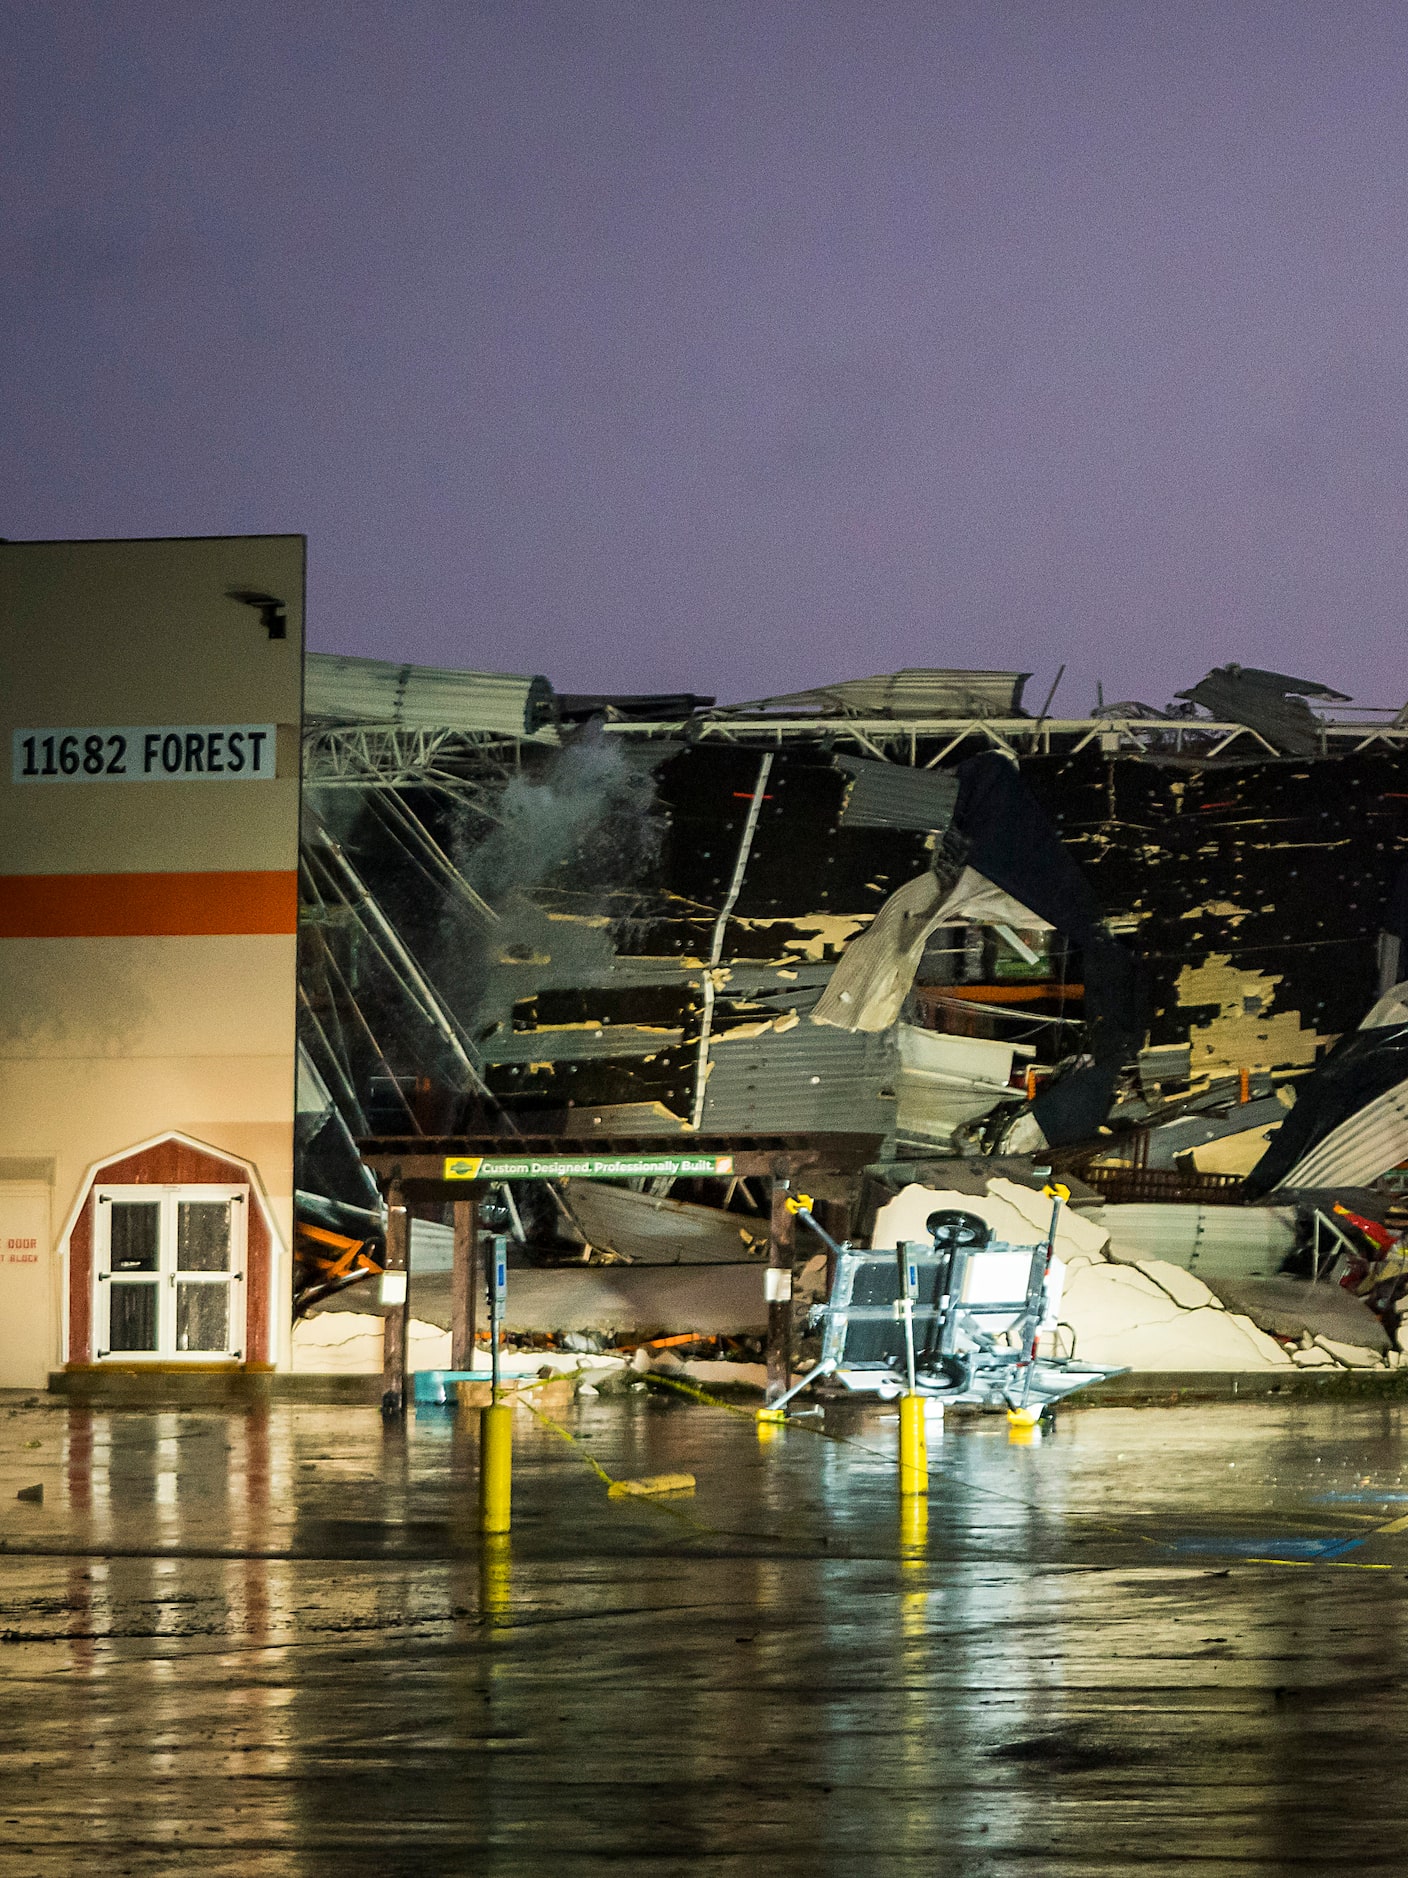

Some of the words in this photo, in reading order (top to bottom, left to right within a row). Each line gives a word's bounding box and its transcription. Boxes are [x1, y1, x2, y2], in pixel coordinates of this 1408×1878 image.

[22, 735, 127, 775] 11682
[144, 732, 266, 773] FOREST
[481, 1163, 529, 1173] Custom
[531, 1162, 593, 1175] Designed.
[594, 1160, 680, 1174] Professionally
[681, 1160, 714, 1171] Built.
[8, 1238, 37, 1249] DOOR
[9, 1254, 38, 1263] BLOCK
